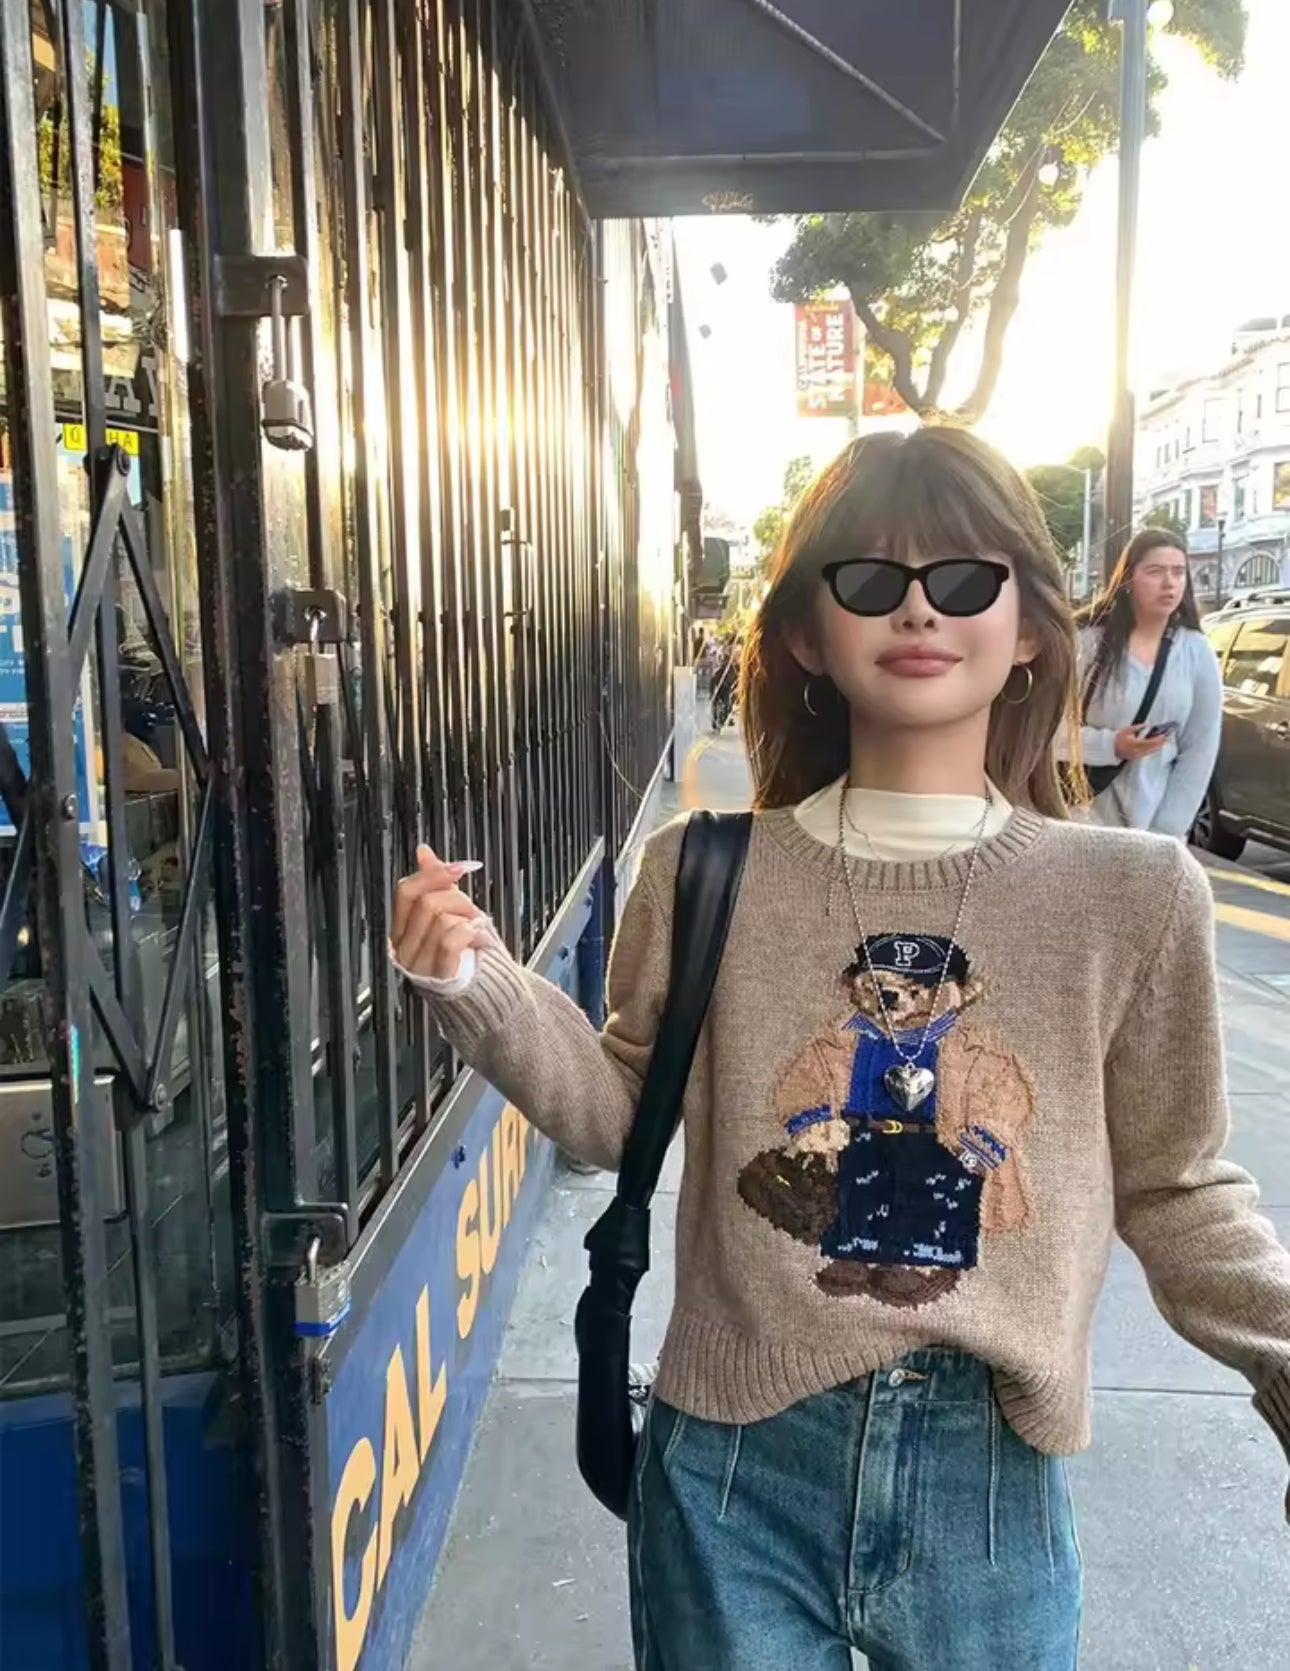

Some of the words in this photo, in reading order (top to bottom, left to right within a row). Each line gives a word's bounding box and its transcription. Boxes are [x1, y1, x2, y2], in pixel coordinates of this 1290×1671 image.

[807, 344, 827, 408] STATE
[826, 313, 844, 402] NATURE
[893, 940, 920, 967] P
[331, 1283, 447, 1671] CAL
